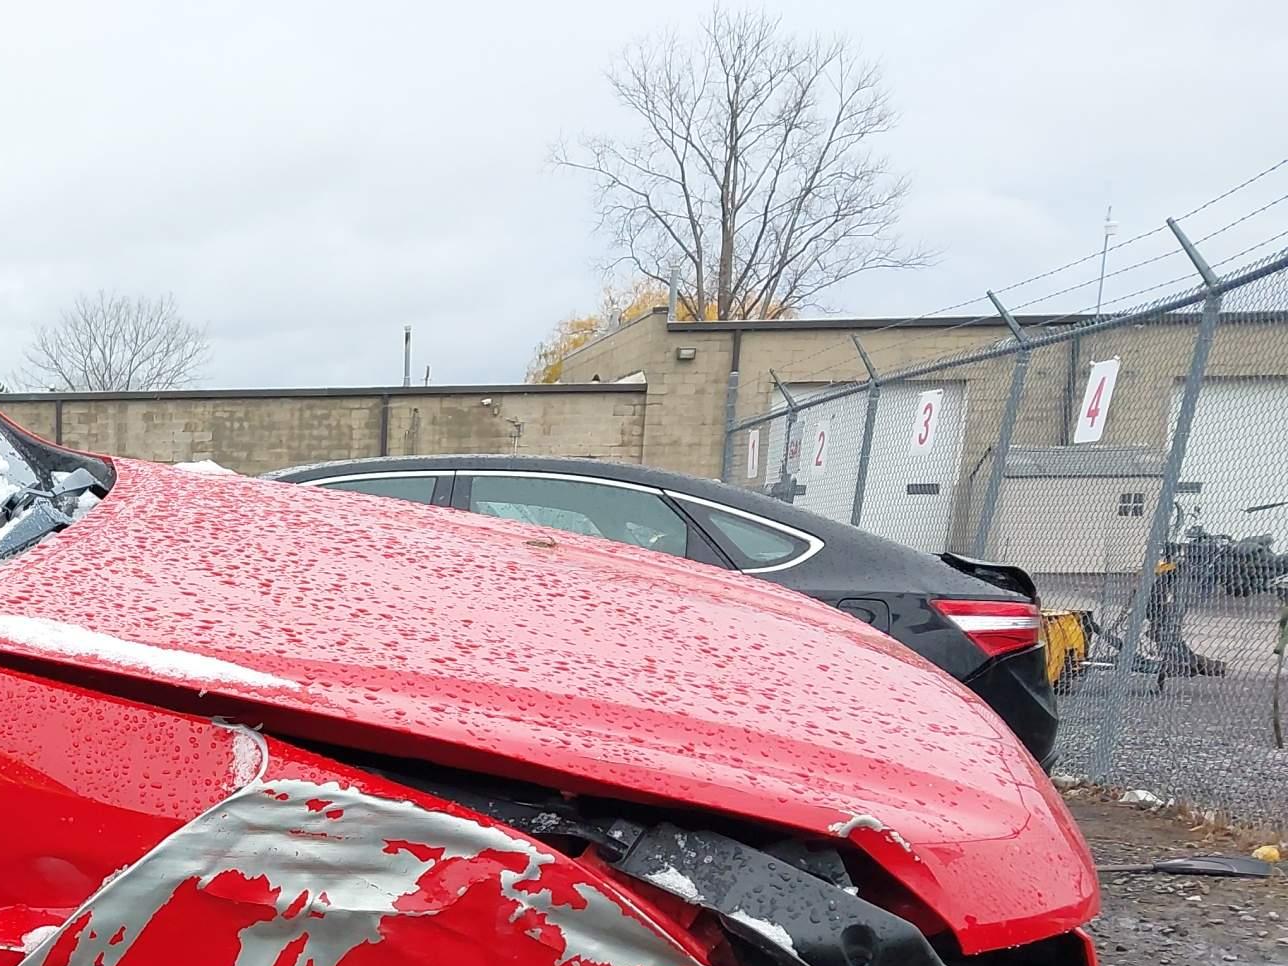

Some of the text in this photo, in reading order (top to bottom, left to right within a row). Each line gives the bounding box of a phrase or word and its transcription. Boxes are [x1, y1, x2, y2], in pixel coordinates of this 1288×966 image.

[918, 402, 933, 445] 3
[1086, 376, 1106, 428] 4
[815, 431, 826, 467] 2
